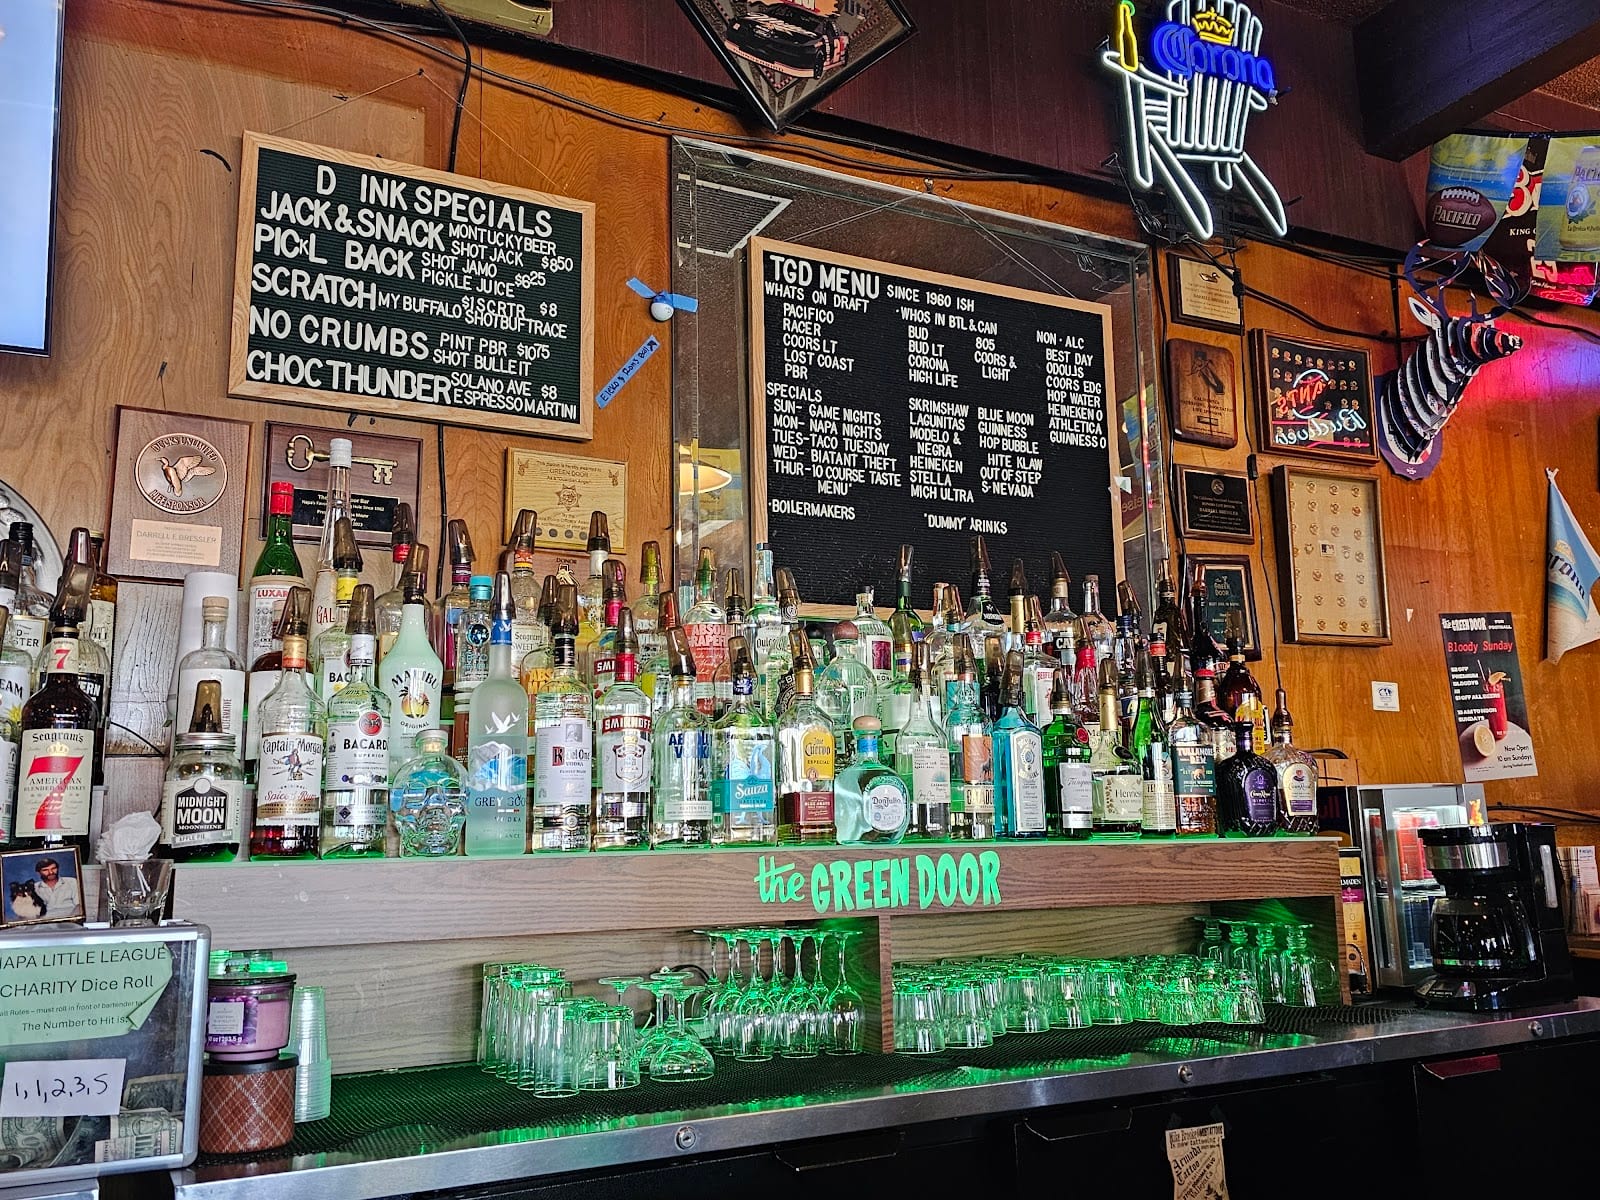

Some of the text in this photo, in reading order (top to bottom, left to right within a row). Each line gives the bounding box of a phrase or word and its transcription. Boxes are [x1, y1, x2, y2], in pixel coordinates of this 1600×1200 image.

[1153, 22, 1276, 91] Corona
[360, 174, 407, 211] INK
[414, 186, 552, 238] SPECIALS
[1432, 204, 1482, 225] PACIFICO
[449, 222, 557, 256] MONTUCKY BEER
[1509, 228, 1531, 236] KING
[345, 240, 415, 280] BACK
[451, 241, 487, 263] SHOT
[489, 248, 524, 268] JACK
[421, 252, 457, 272] SHOT
[462, 259, 498, 278] JAMO
[251, 263, 377, 311] SCRATCH
[770, 255, 880, 299] TGD MENU
[476, 278, 516, 298] JUICE
[765, 281, 869, 313] WHATS ON DRAFT
[886, 284, 975, 312] SINCE 1960 ISH
[378, 291, 462, 319] MY BUFFALO
[539, 302, 558, 317] $8
[783, 303, 834, 324] PACIFICO
[900, 307, 946, 327] WHOS IN
[249, 305, 430, 361] NO CRUMBS
[783, 318, 821, 337] RACER
[908, 325, 929, 340] BUD
[440, 332, 475, 353] PINT
[479, 339, 507, 357] PBR
[783, 333, 838, 354] COORS LT
[908, 339, 945, 357] BUD LT
[975, 336, 996, 351] 805
[1036, 330, 1085, 350] NON ALC
[432, 349, 532, 378] SHOT BULLEIT
[784, 348, 854, 372] LOST COAST
[908, 354, 949, 373] CORONA
[974, 351, 1007, 367] COORS
[1045, 348, 1094, 367] BEST DAY
[247, 350, 451, 405] CHOC THUNDER
[784, 363, 808, 380] PBR
[908, 369, 959, 389] HIGH LIFE
[981, 366, 1011, 382] LIGHT
[450, 372, 558, 400] SOLANO AVE $8
[767, 382, 823, 402] SPECIALS
[1045, 376, 1102, 395] COORS EDG
[453, 389, 577, 420] ESPRESSO MARTINI
[908, 397, 969, 418] SKRIMSHAW
[1046, 389, 1101, 408] HOP WATER
[808, 403, 840, 421] GAME
[843, 407, 882, 426] NIGHTS
[978, 407, 1034, 426] BLUE MOON
[1048, 403, 1095, 420] HEINEKEN
[809, 418, 838, 435] NAPA
[842, 423, 882, 441] NIGHTS
[909, 412, 965, 432] LAGUNITAS
[977, 422, 1028, 439] GUINNESS
[1049, 416, 1103, 435] ATHLETICA
[909, 426, 950, 444] MODELO
[979, 435, 1039, 455] HOP BUBBLE
[1050, 430, 1099, 448] GUINNESS
[843, 437, 890, 457] TUESDAY
[917, 442, 952, 458] NEGRA
[862, 454, 897, 472] THEFT
[909, 455, 963, 475] HEINEKEN
[1016, 456, 1043, 471] KLAW
[825, 466, 902, 487] COURSE TASTE
[909, 470, 952, 487] STELLA
[980, 466, 1042, 485] OUT OF STEP
[910, 484, 974, 503] MICH ULTRA
[1447, 641, 1513, 654] Bloody Sunday
[54, 649, 70, 670] 7
[391, 669, 440, 689] MAIBU
[32, 732, 84, 743] Seagram's
[26, 754, 85, 831] 7
[735, 784, 769, 799] Sauza
[178, 796, 226, 809] MIDNIGHT
[177, 807, 225, 825] MOON
[753, 850, 1002, 914] the GREEN DOOR
[42, 947, 166, 967] LITTLE LEAGUE
[0, 975, 153, 998] CHARITY Dice Roll
[22, 1022, 41, 1032] The
[43, 1019, 85, 1030] Number
[88, 1018, 98, 1026] to
[100, 1016, 114, 1025] Hit
